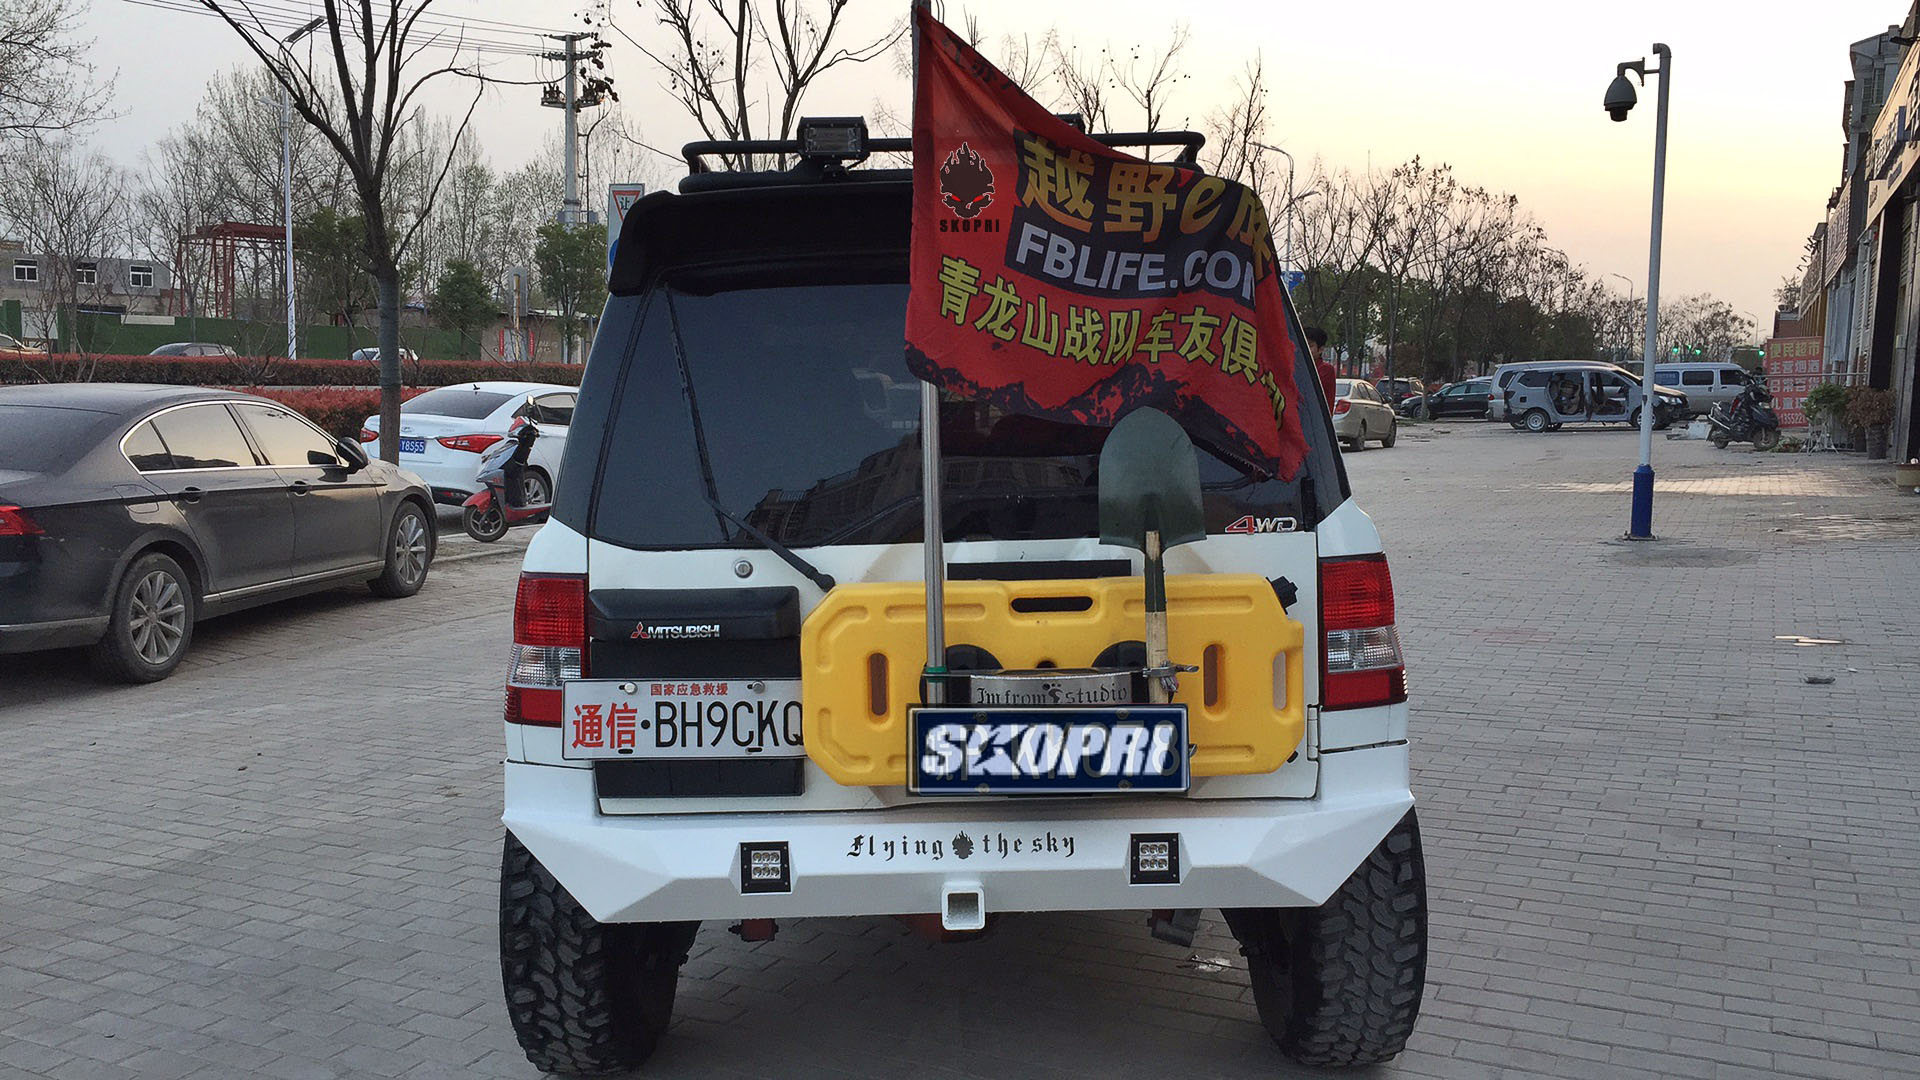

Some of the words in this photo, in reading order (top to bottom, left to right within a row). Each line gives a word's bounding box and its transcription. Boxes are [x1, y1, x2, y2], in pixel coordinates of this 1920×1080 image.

[1224, 514, 1297, 535] 4WD
[647, 624, 721, 640] MITSUBISHI
[650, 682, 729, 697] 国家应急救援
[1004, 689, 1047, 704] from
[1065, 683, 1128, 704] studio
[847, 834, 944, 861] Flying
[982, 832, 1023, 859] the
[1031, 831, 1075, 857] sky
